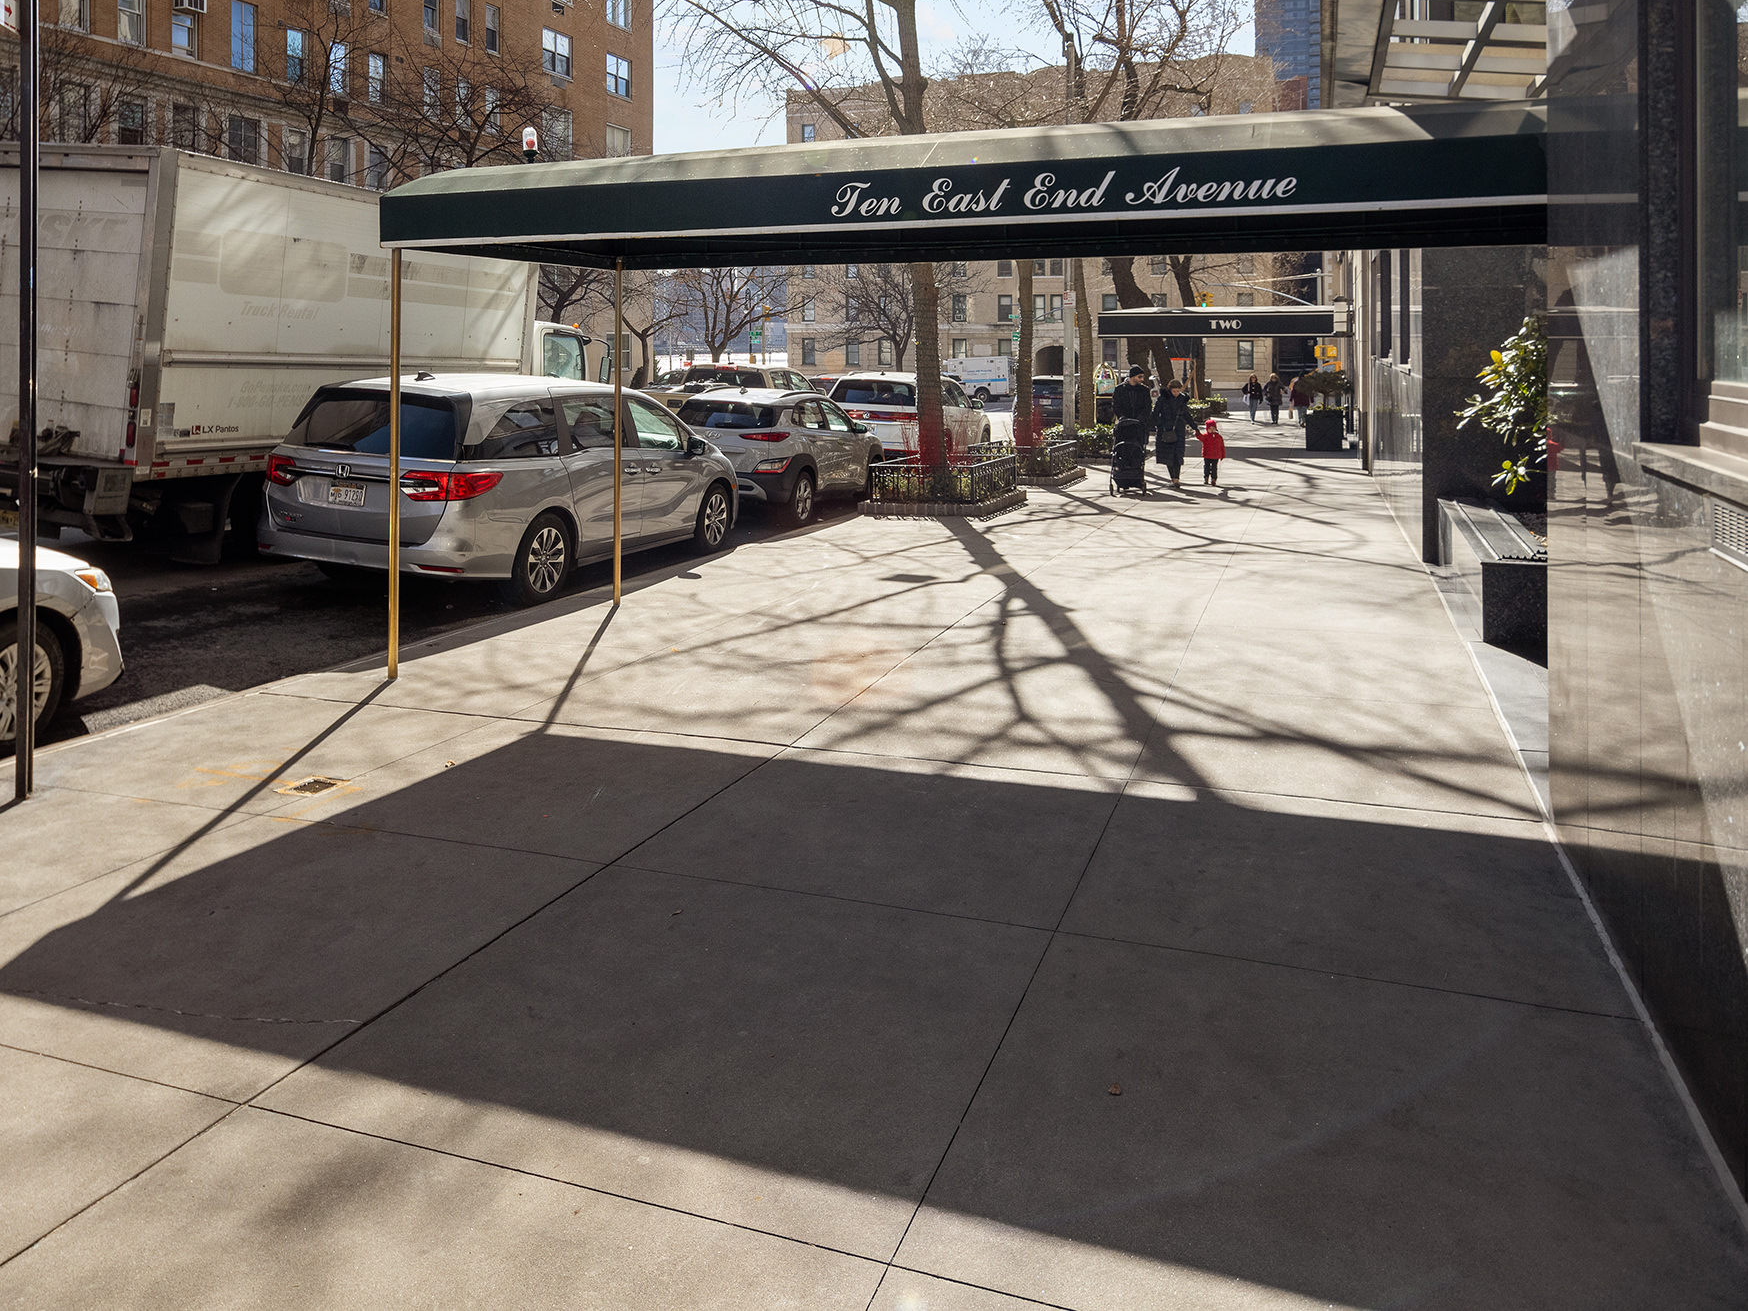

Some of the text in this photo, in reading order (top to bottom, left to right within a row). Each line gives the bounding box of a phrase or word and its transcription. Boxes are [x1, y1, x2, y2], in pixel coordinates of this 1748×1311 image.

[831, 166, 1297, 217] Ten East End Avenue
[240, 300, 321, 321] Truck Rental
[1208, 319, 1242, 330] TWO
[202, 424, 239, 434] LX Pantos
